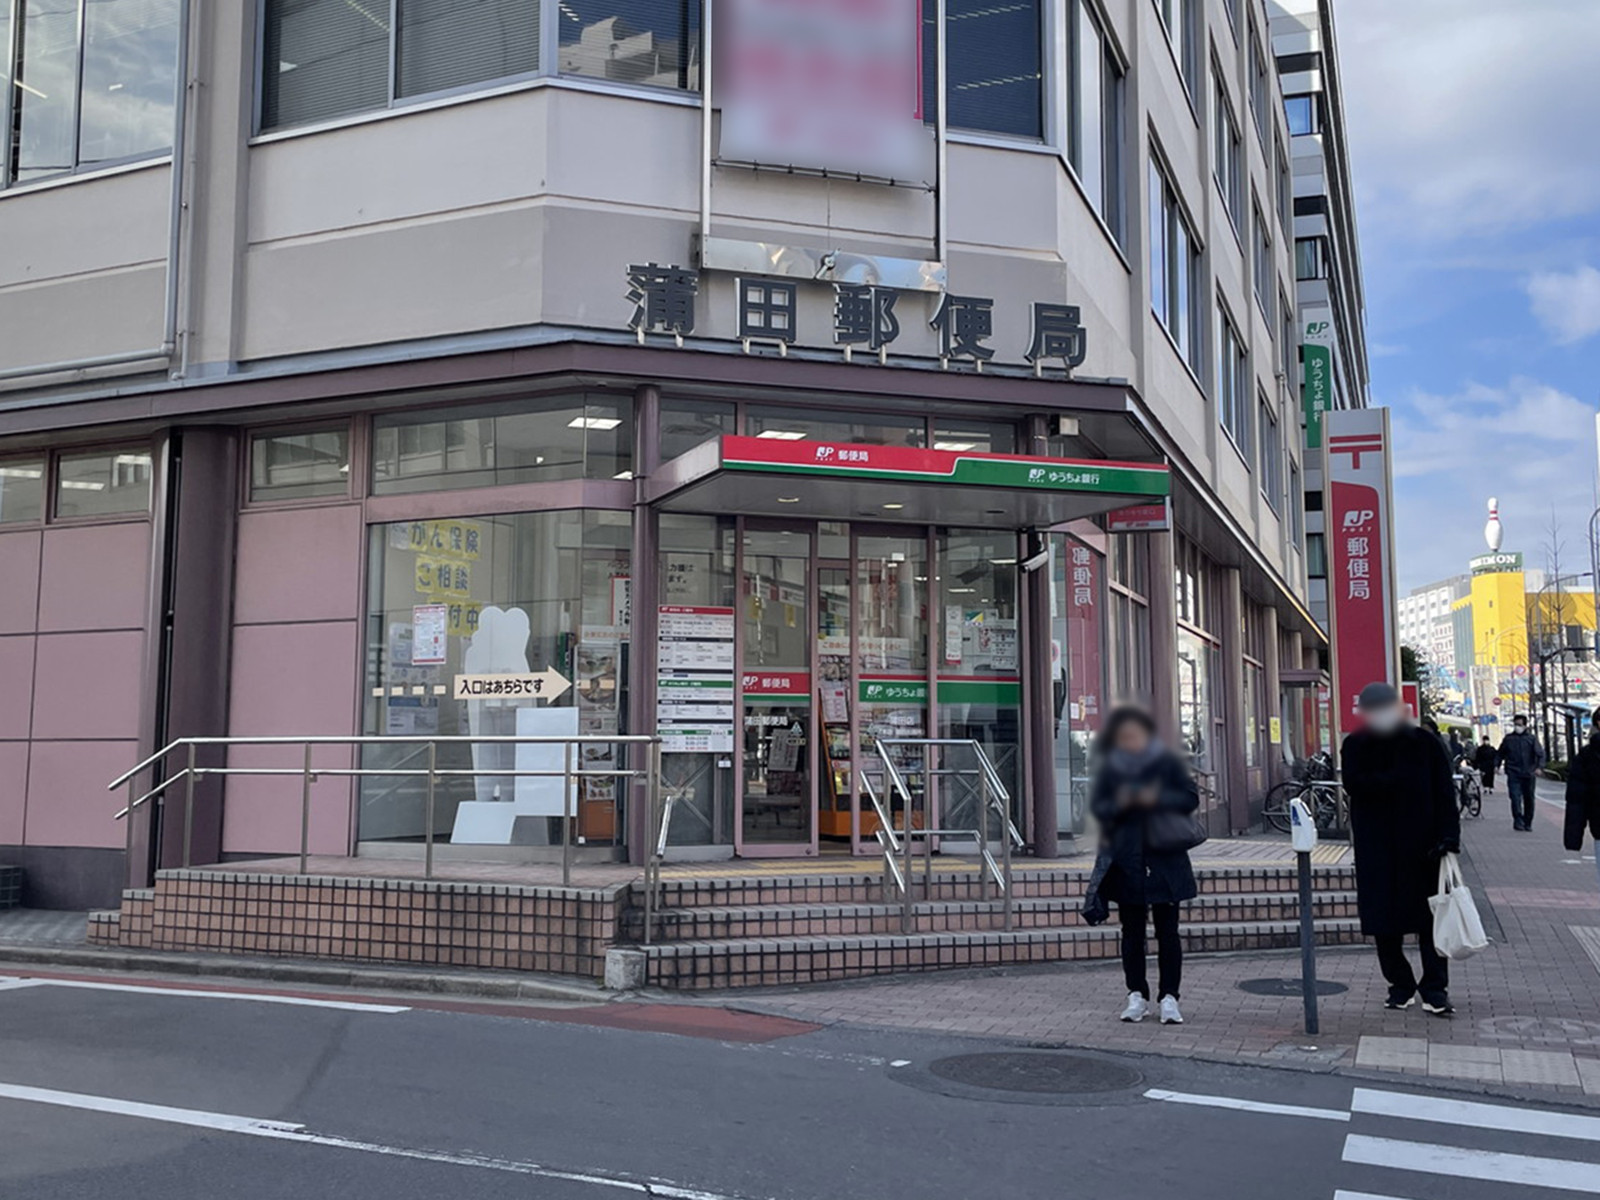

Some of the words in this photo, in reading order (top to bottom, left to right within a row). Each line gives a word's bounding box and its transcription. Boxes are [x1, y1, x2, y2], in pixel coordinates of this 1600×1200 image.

[625, 262, 1087, 369] 蒲田郵便局
[838, 449, 869, 462] 郵便局
[1049, 471, 1100, 485] ゆうちょ銀行
[1347, 536, 1371, 600] 郵便局
[460, 678, 544, 695] 入口はあちらです
[762, 678, 790, 688] 郵便局
[885, 687, 925, 698] ゆうちょ銀
